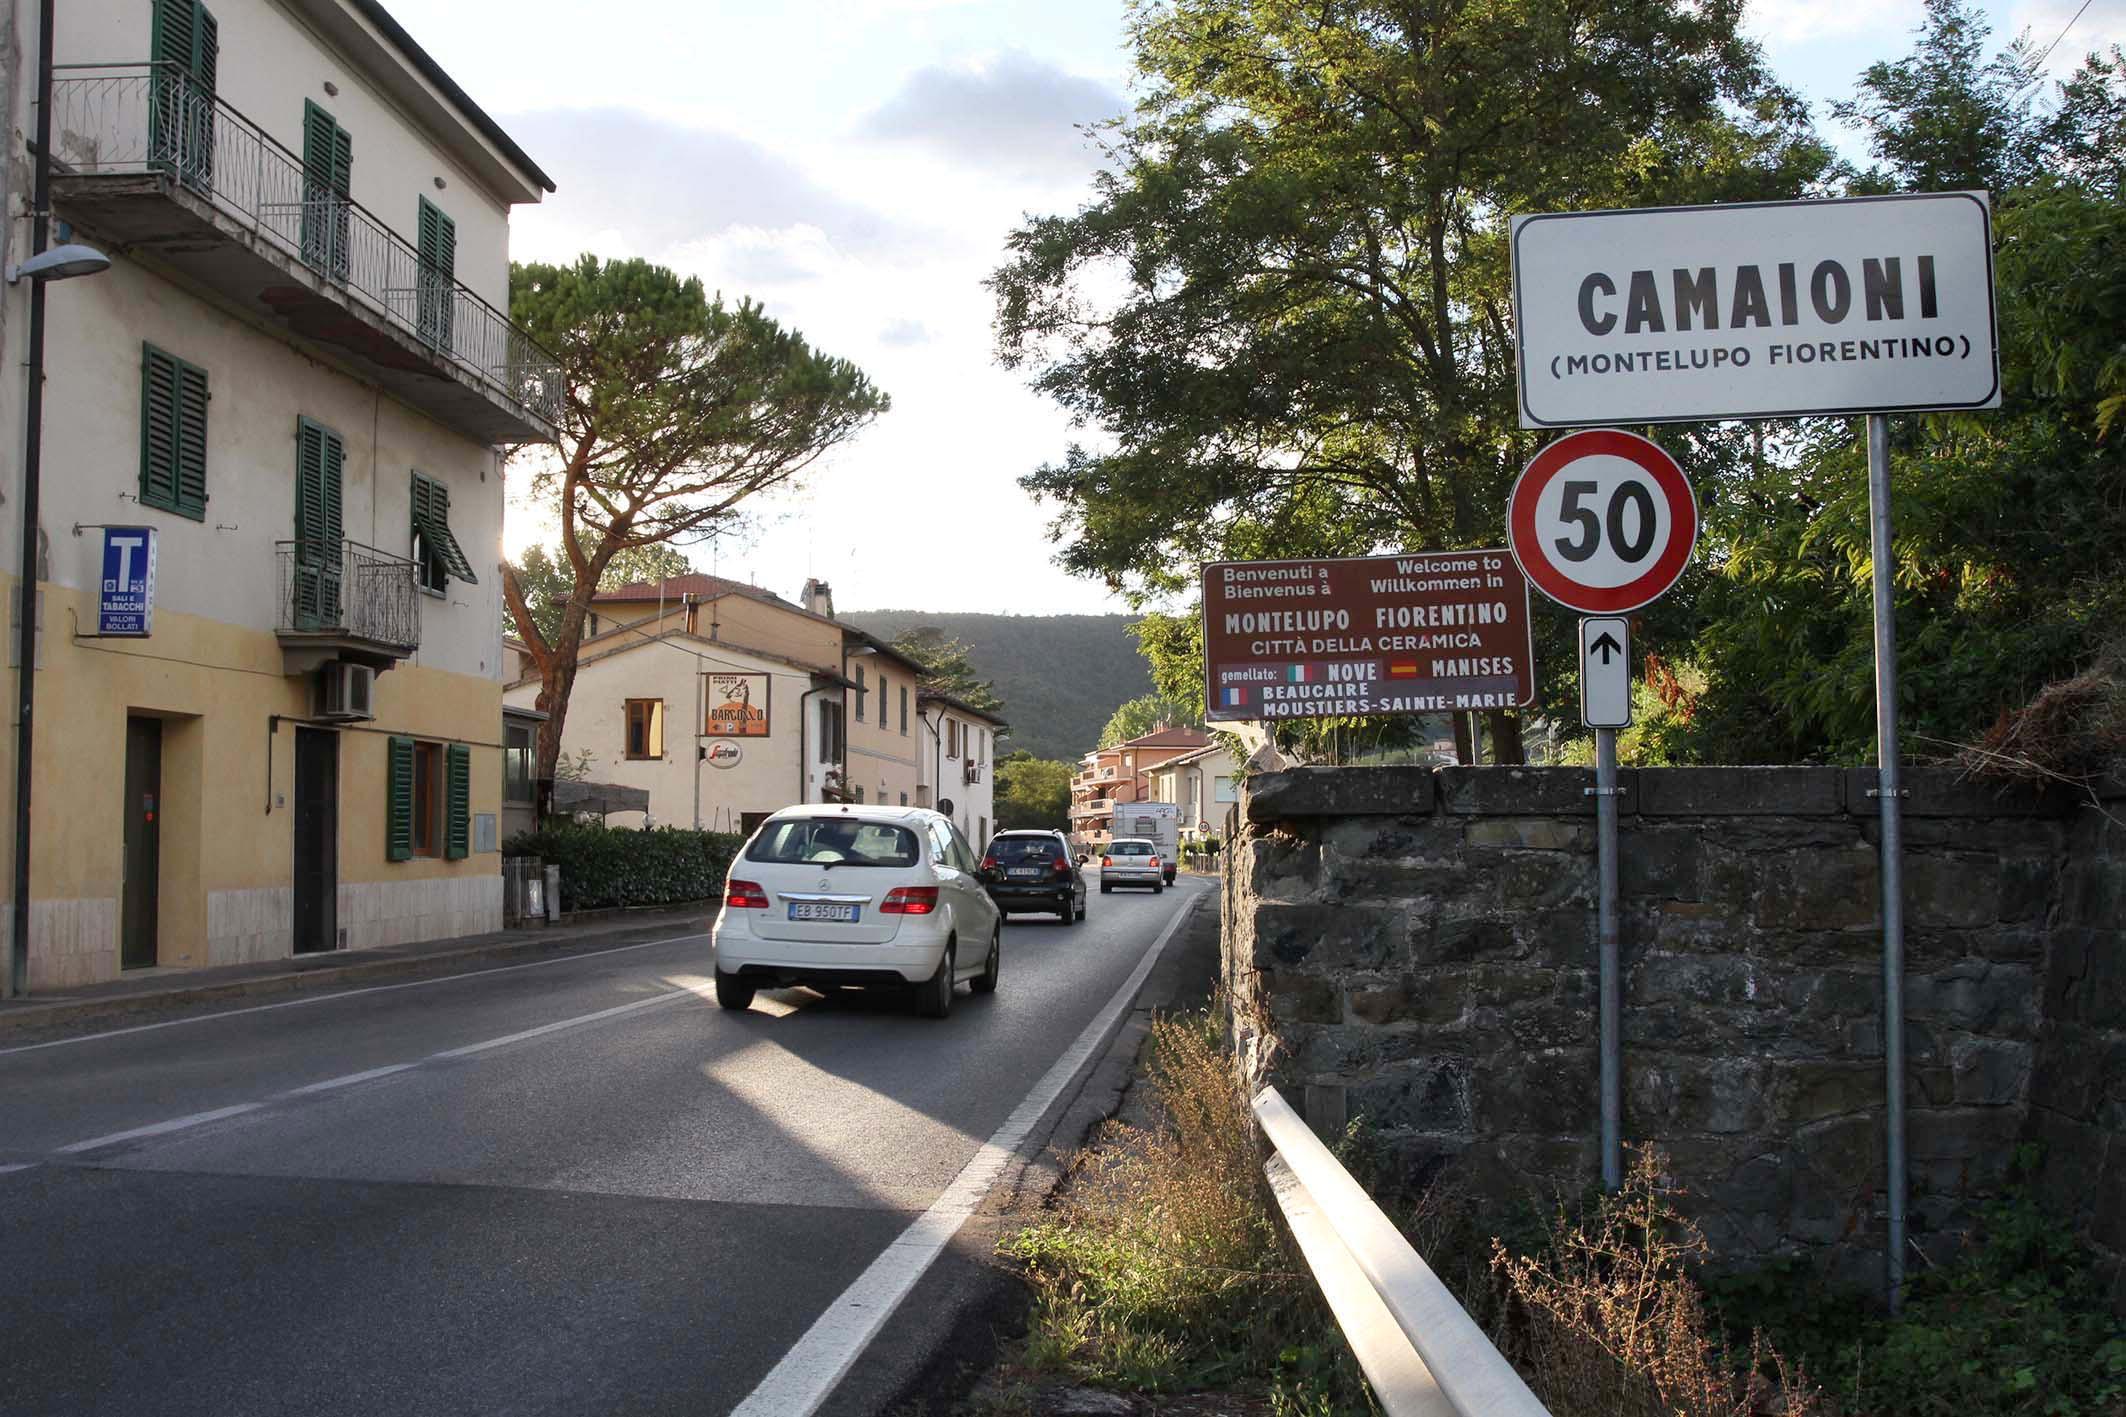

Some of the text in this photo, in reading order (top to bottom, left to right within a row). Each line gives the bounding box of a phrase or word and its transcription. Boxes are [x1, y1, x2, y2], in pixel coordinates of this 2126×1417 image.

[1577, 255, 1938, 337] CAMAIONI
[1550, 335, 1971, 380] (MONTELUPO FIORENTINO)
[1555, 480, 1656, 563] 50
[110, 537, 142, 592] T
[1223, 565, 1329, 583] Benvenuti a
[1397, 557, 1502, 576] Welcome to
[1224, 581, 1331, 600] Bienvenus à
[1370, 574, 1503, 593] Willkommen in
[102, 602, 144, 612] TABACCHI
[105, 623, 138, 631] BOLLATI
[109, 615, 137, 623] VALORI
[1225, 602, 1507, 634] MONTELUPO FIORENTINO
[1251, 632, 1482, 656] CITTÀ DELLA CERAMICA
[1221, 663, 1377, 683] gemellato: NOVE
[1432, 657, 1513, 678] MANISES
[1263, 682, 1369, 700] BEAUCAIRE
[1263, 692, 1516, 717] MOUSTIERS-SAINTE-MARIE
[797, 905, 850, 918] EB 950TF
